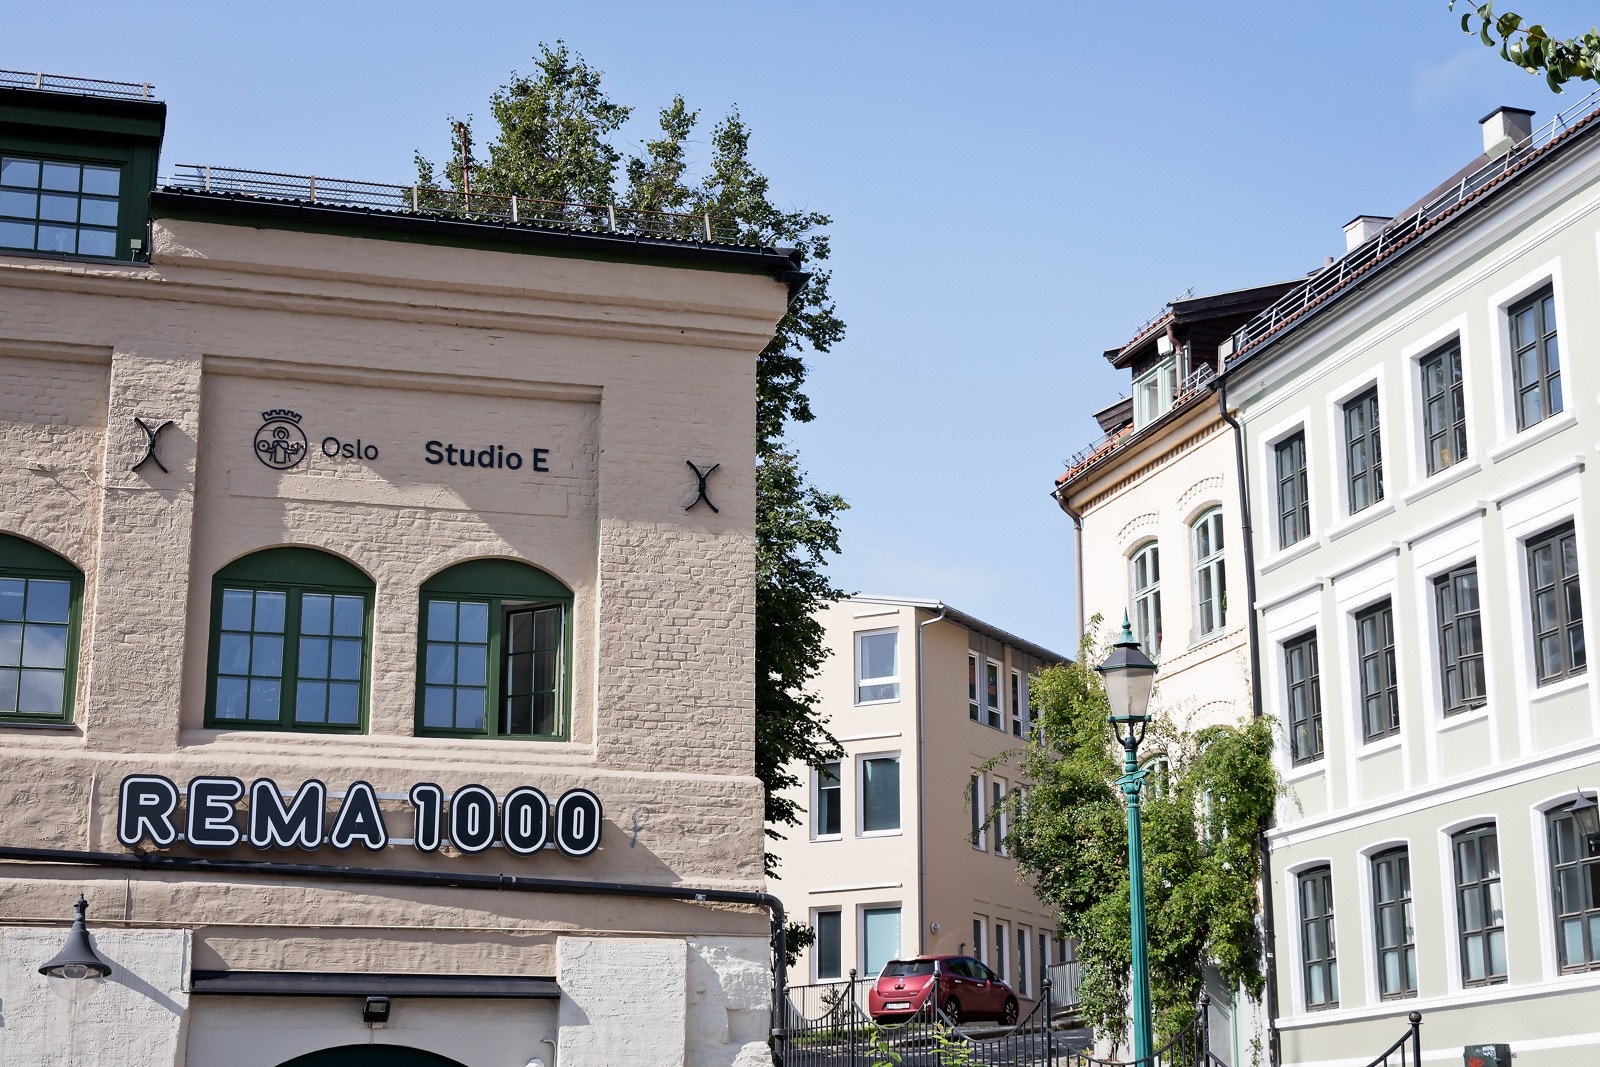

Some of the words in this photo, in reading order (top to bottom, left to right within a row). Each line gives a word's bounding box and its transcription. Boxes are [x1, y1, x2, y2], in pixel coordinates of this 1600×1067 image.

[321, 436, 379, 460] Oslo
[424, 440, 522, 470] Studio
[533, 448, 549, 472] E
[117, 774, 389, 850] REMA
[409, 782, 603, 859] 1000
